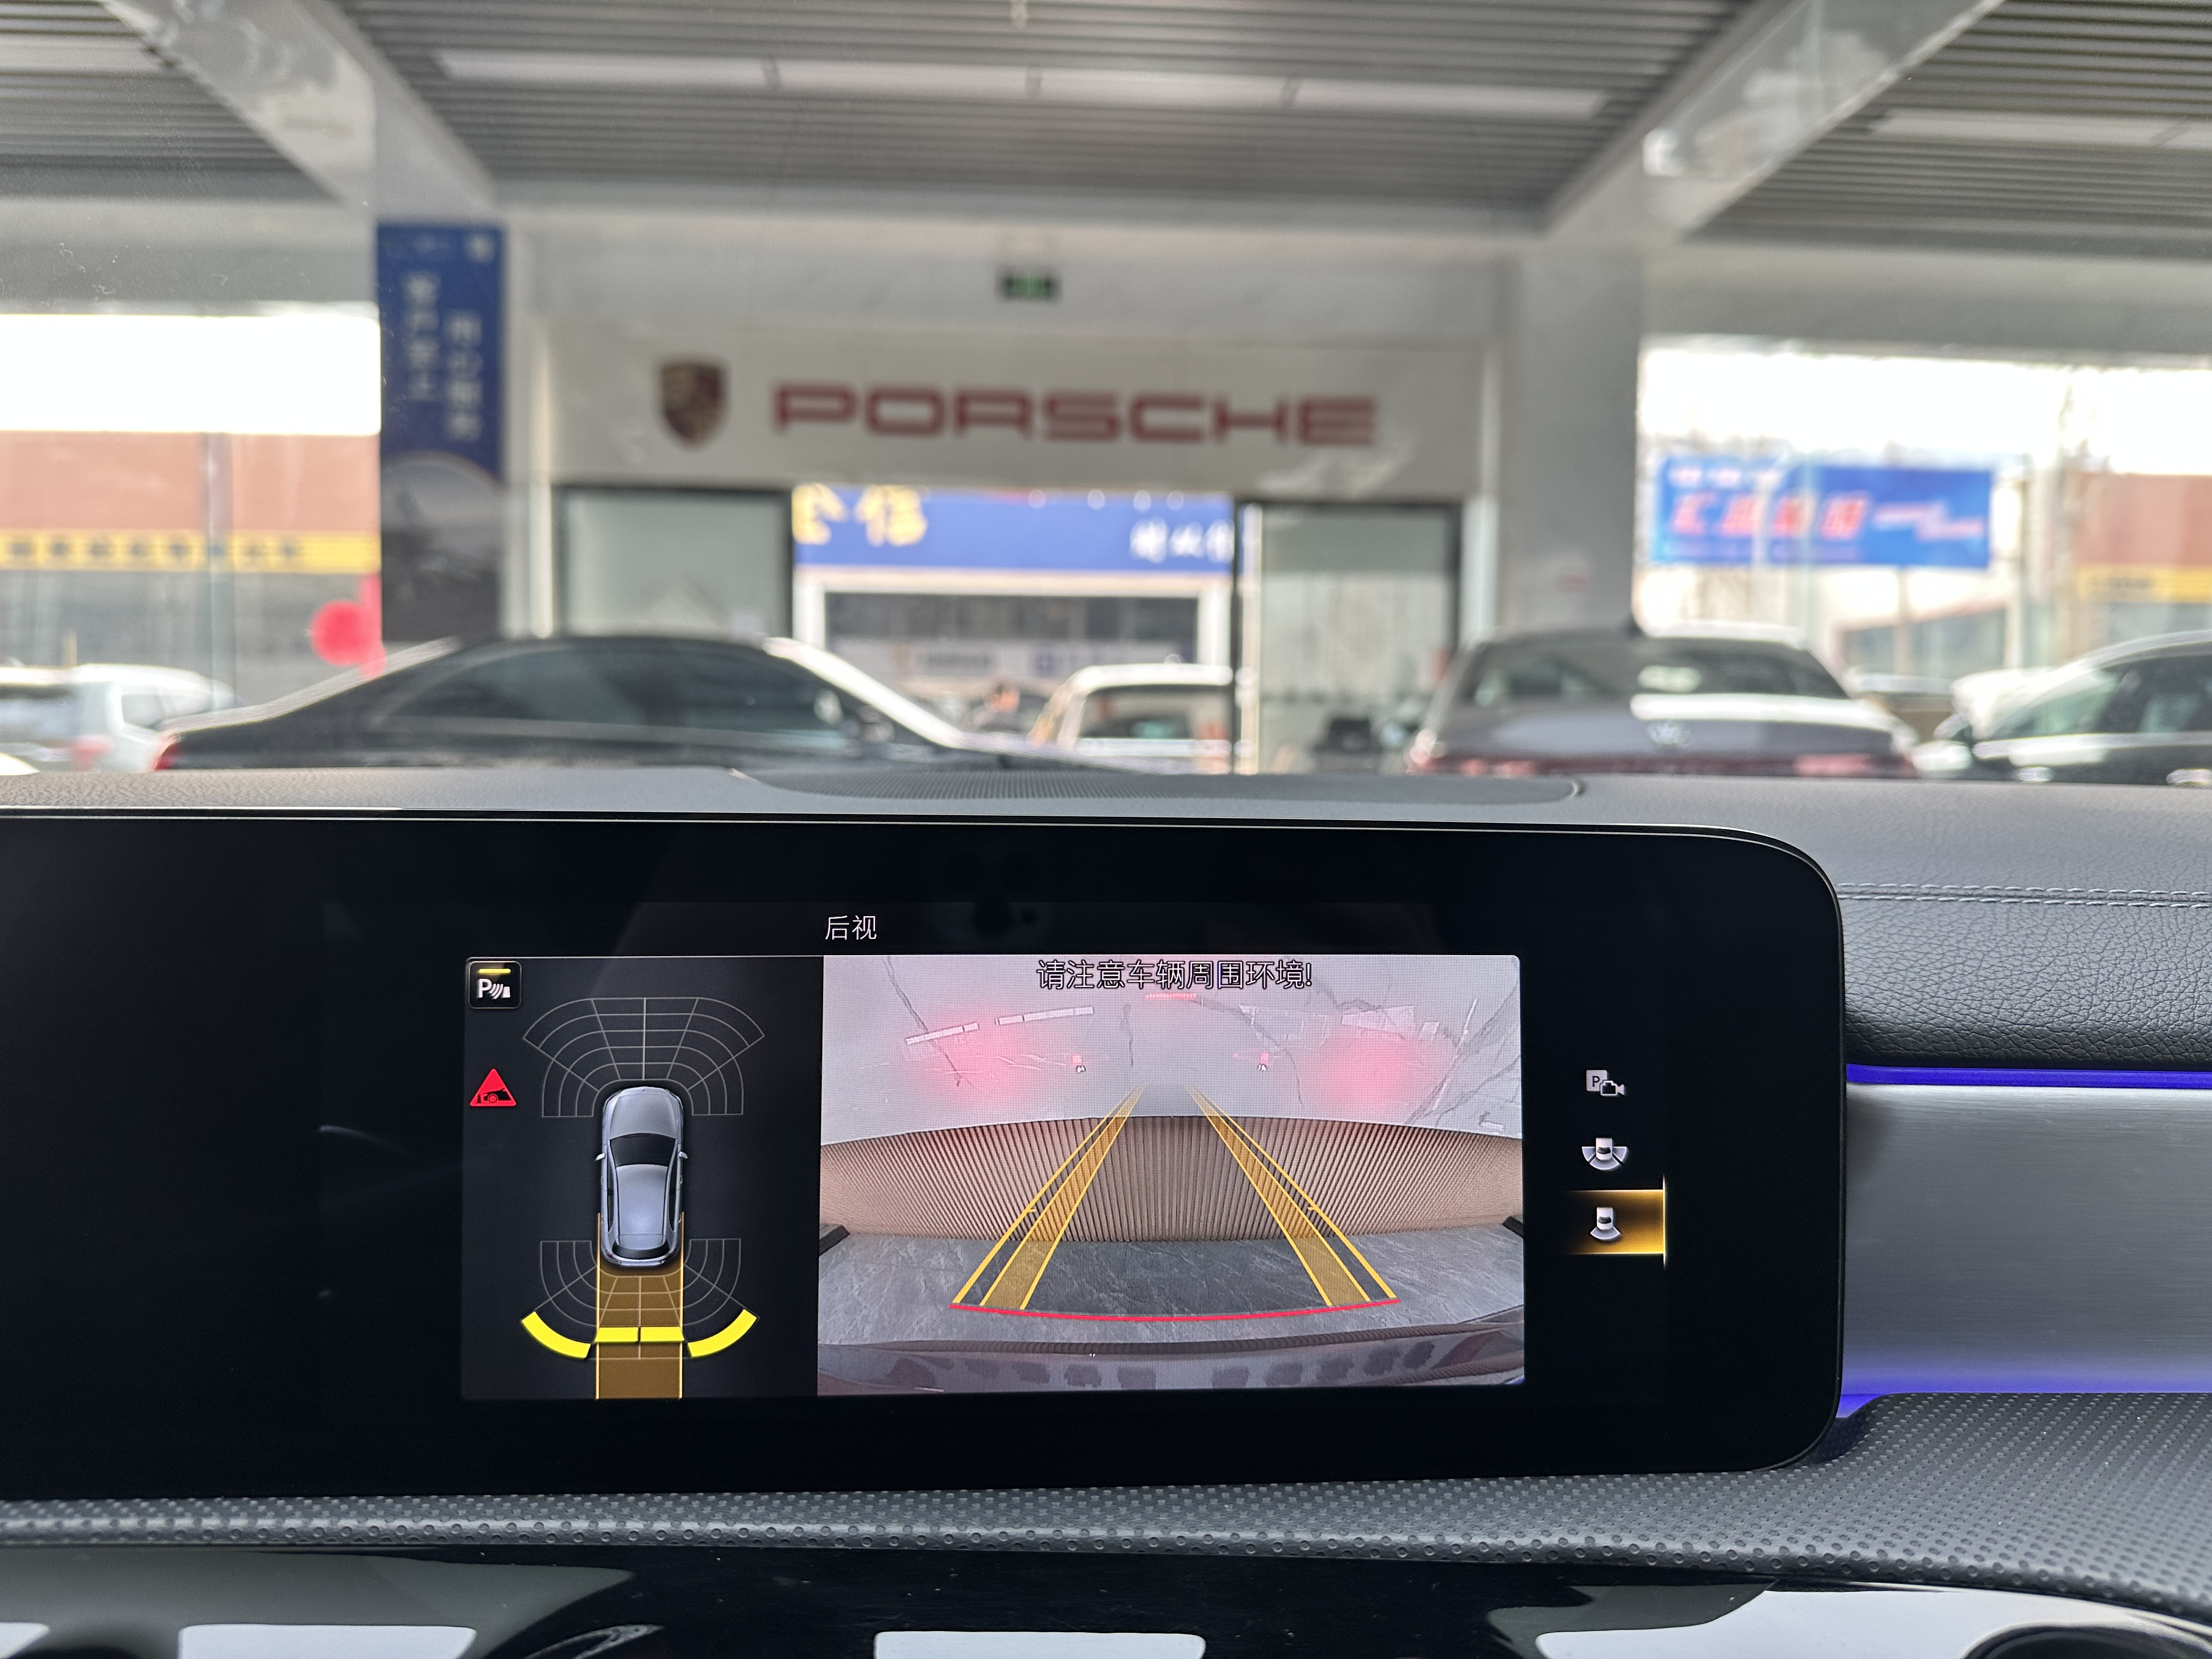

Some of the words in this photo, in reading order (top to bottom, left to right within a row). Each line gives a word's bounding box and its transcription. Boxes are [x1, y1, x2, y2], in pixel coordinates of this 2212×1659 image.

[774, 382, 1378, 445] PORSCHE
[825, 915, 877, 940] 后视
[1036, 960, 1312, 989] 请注意车辆周围环境!
